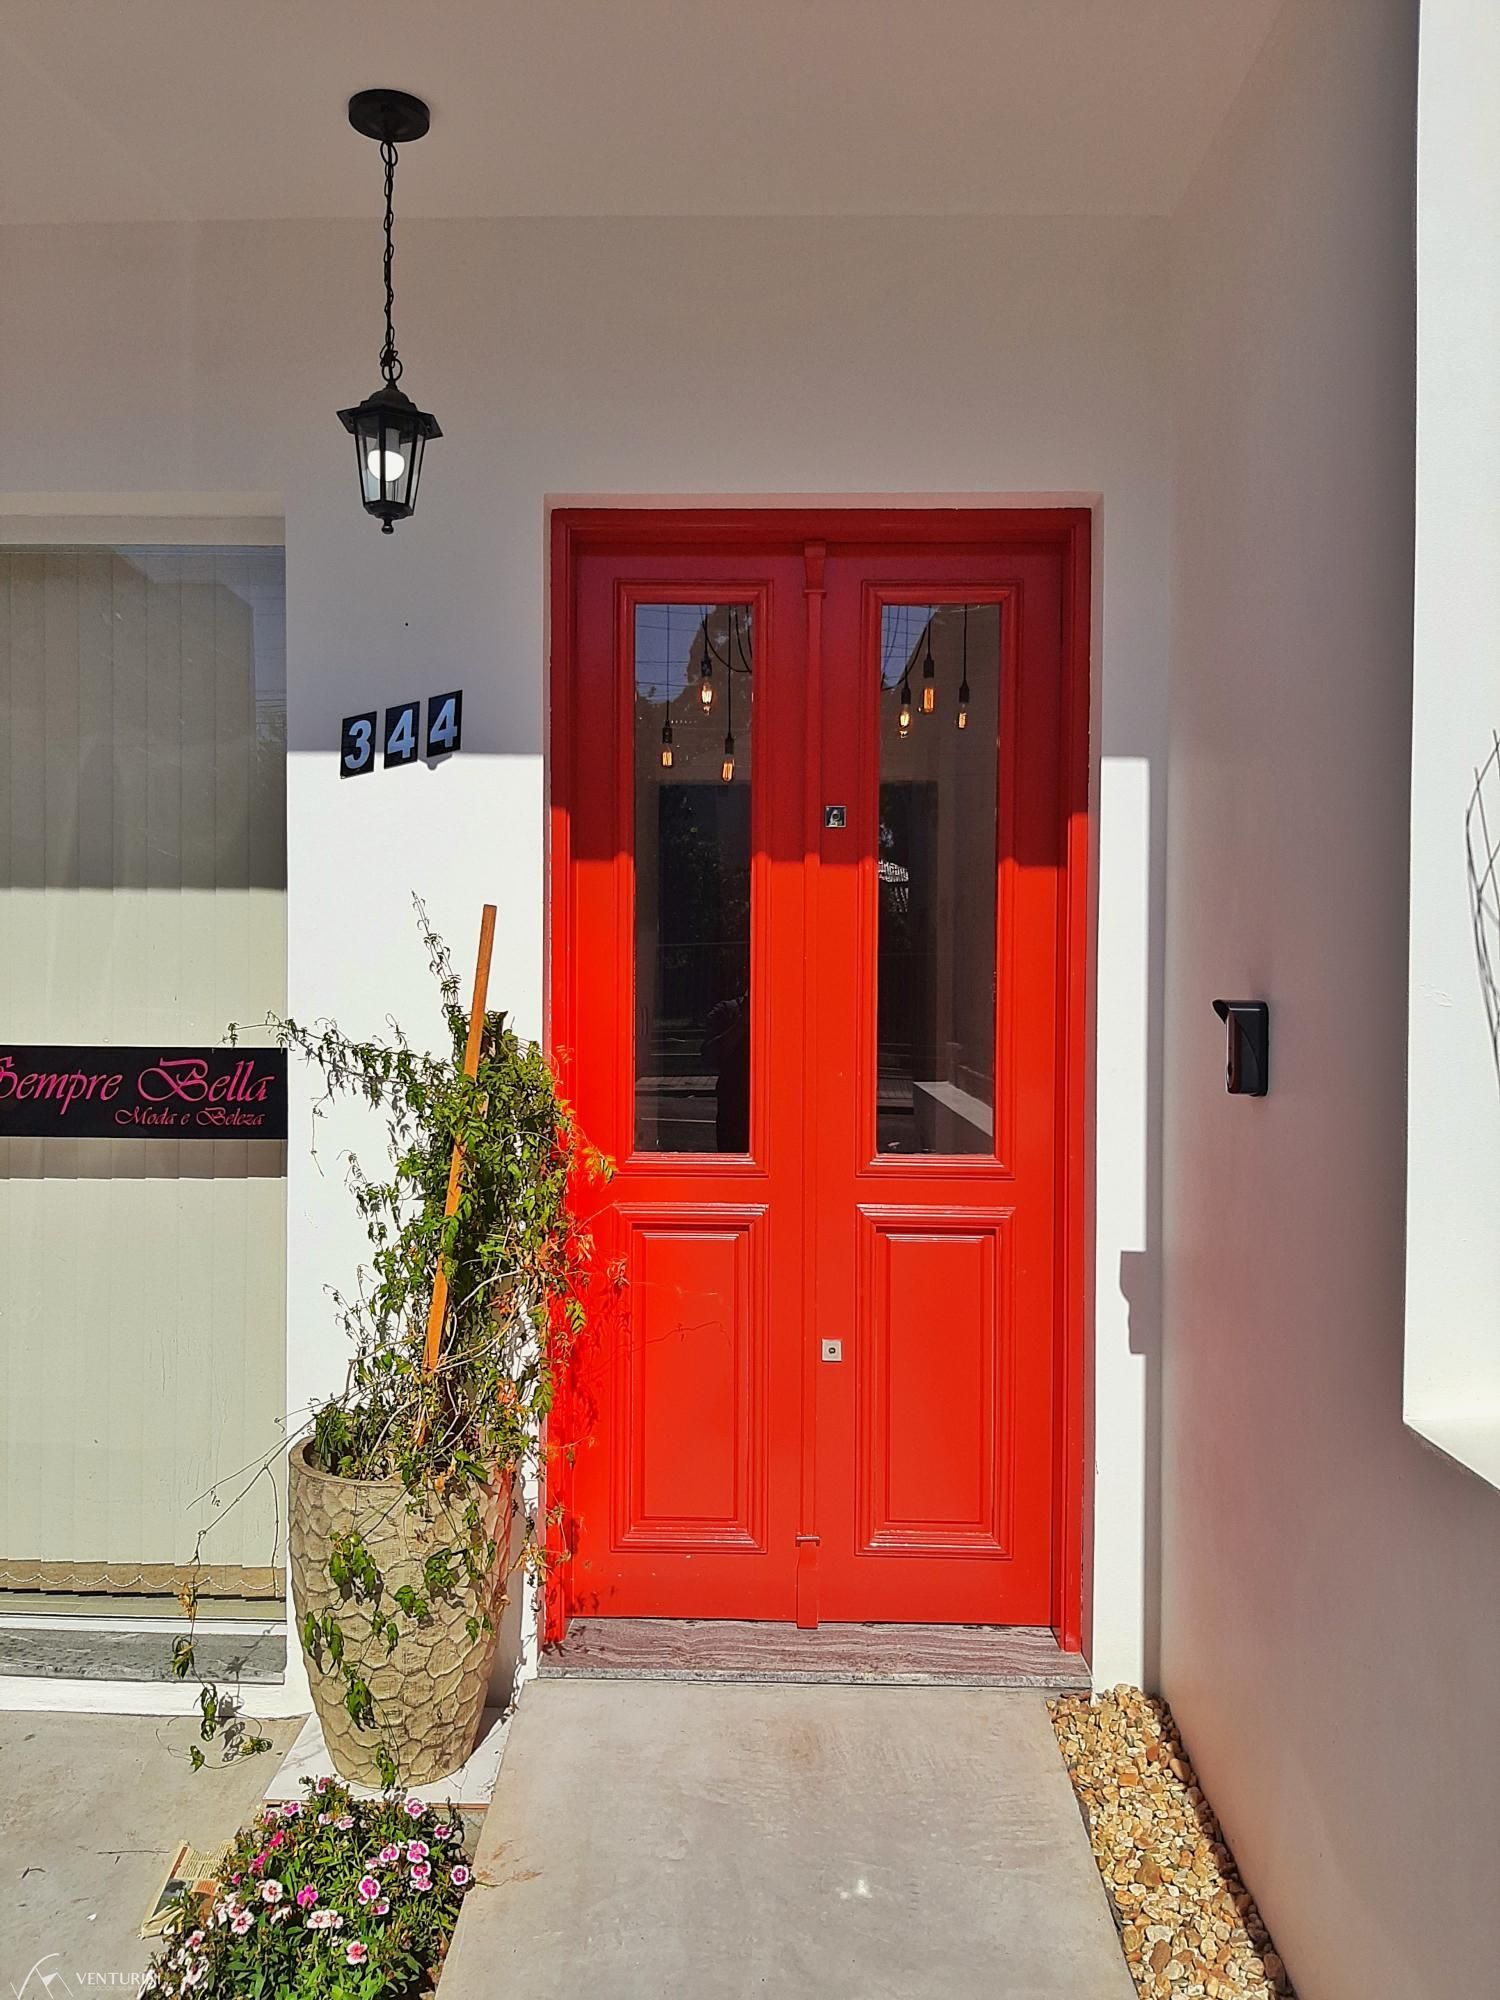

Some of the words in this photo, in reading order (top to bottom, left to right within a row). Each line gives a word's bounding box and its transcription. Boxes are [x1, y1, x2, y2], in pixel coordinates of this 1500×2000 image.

[344, 698, 458, 769] 344
[137, 1057, 275, 1102] Bella
[115, 1106, 178, 1125] Moda
[180, 1113, 191, 1125] e
[196, 1107, 266, 1126] Beleza
